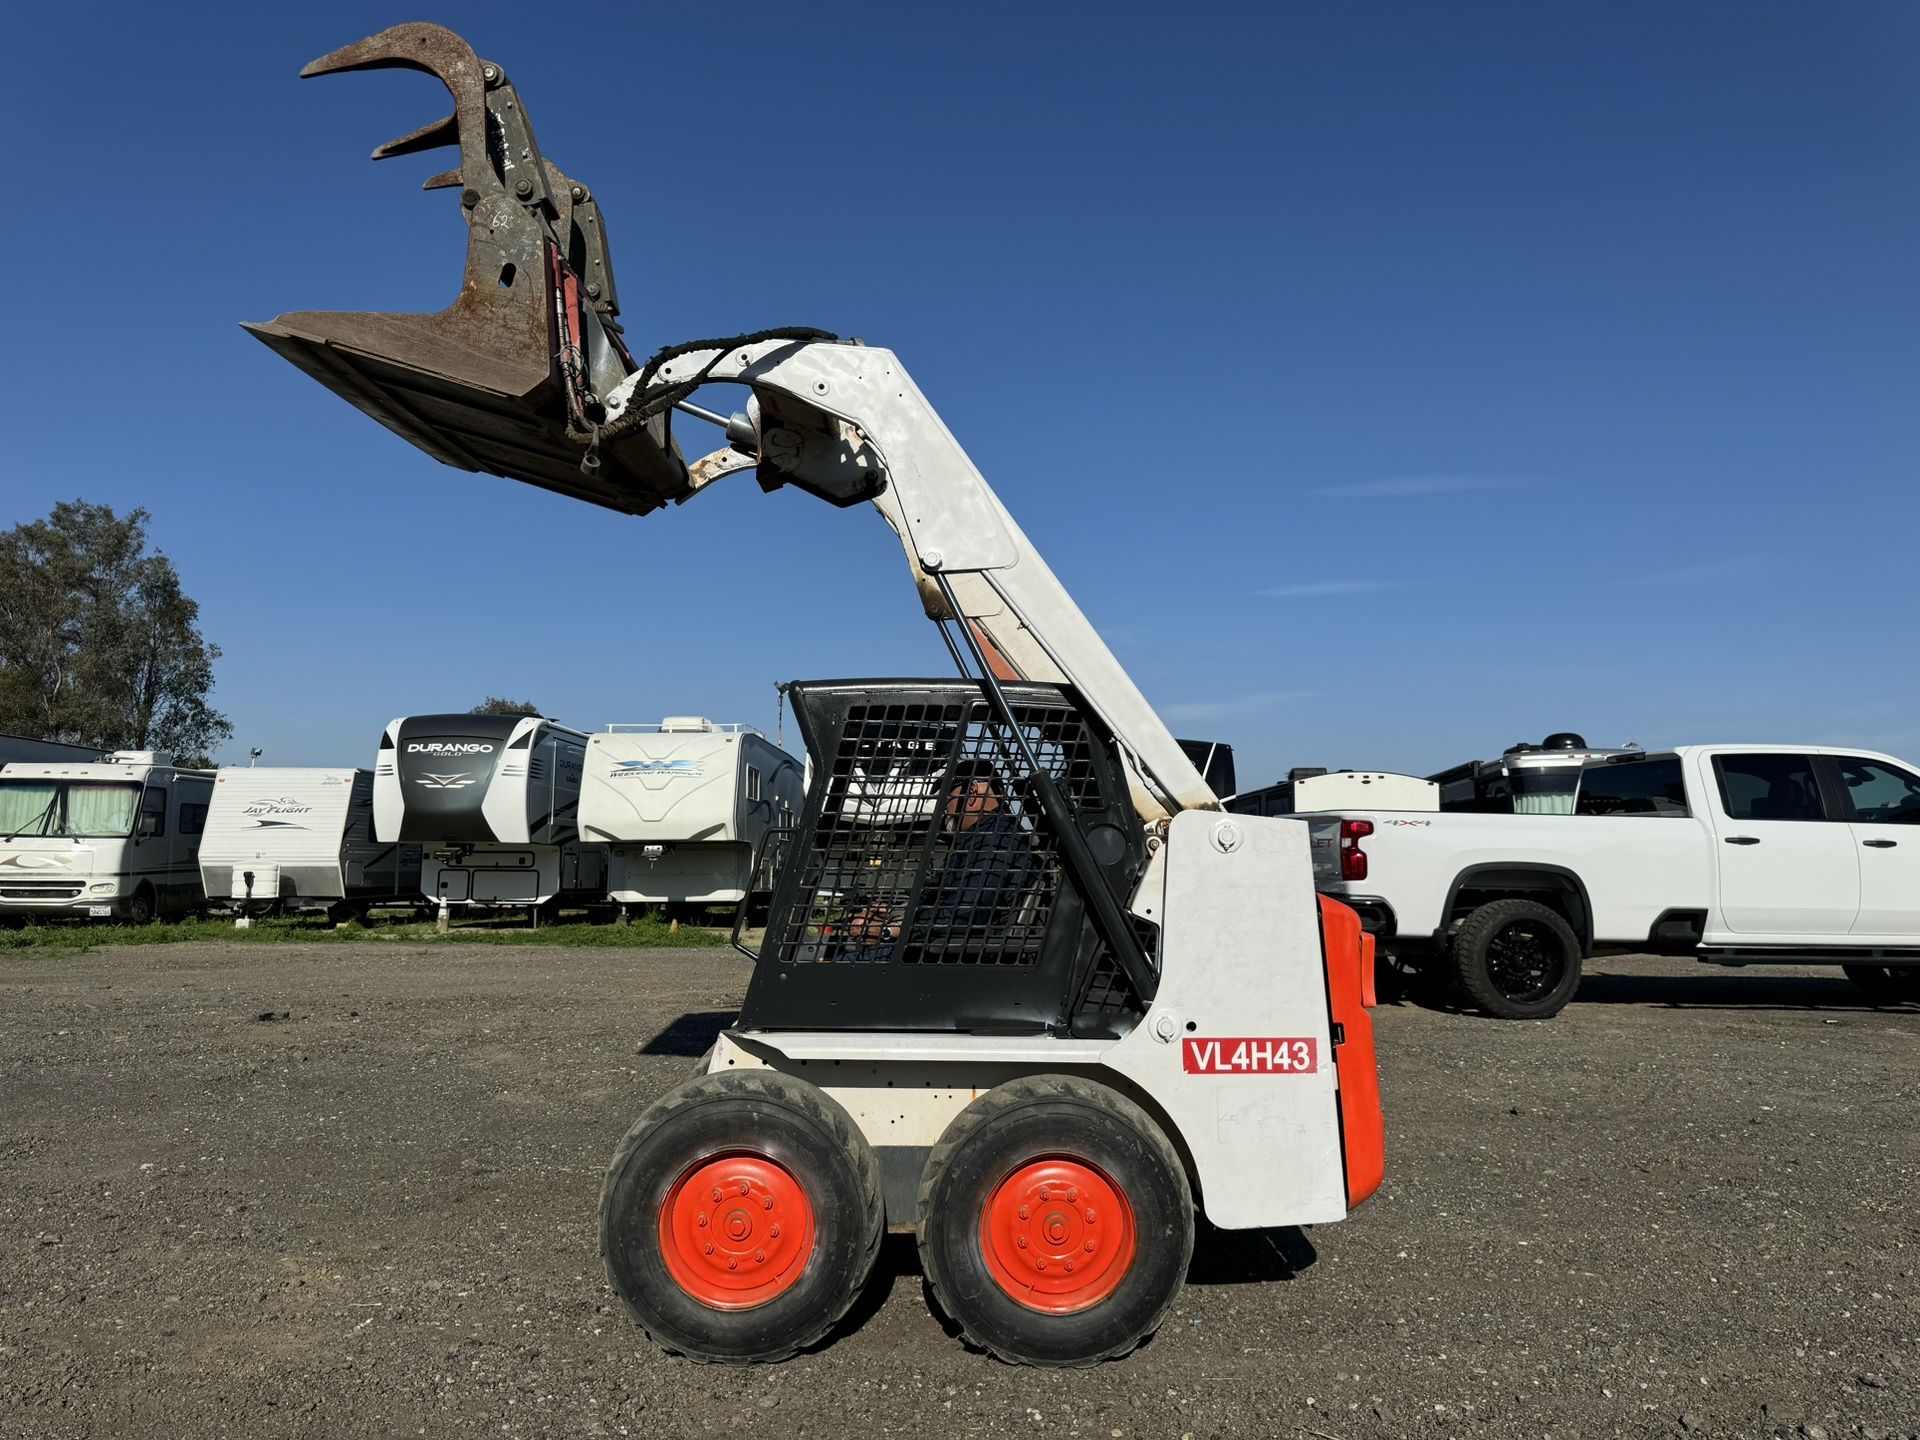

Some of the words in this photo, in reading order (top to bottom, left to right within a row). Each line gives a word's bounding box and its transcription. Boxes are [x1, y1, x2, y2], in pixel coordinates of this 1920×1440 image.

[407, 743, 494, 753] DURANGO
[559, 759, 583, 772] DURANG
[242, 806, 267, 814] JAY
[267, 806, 312, 814] FLIGHT
[1190, 1041, 1310, 1071] VL4H43
